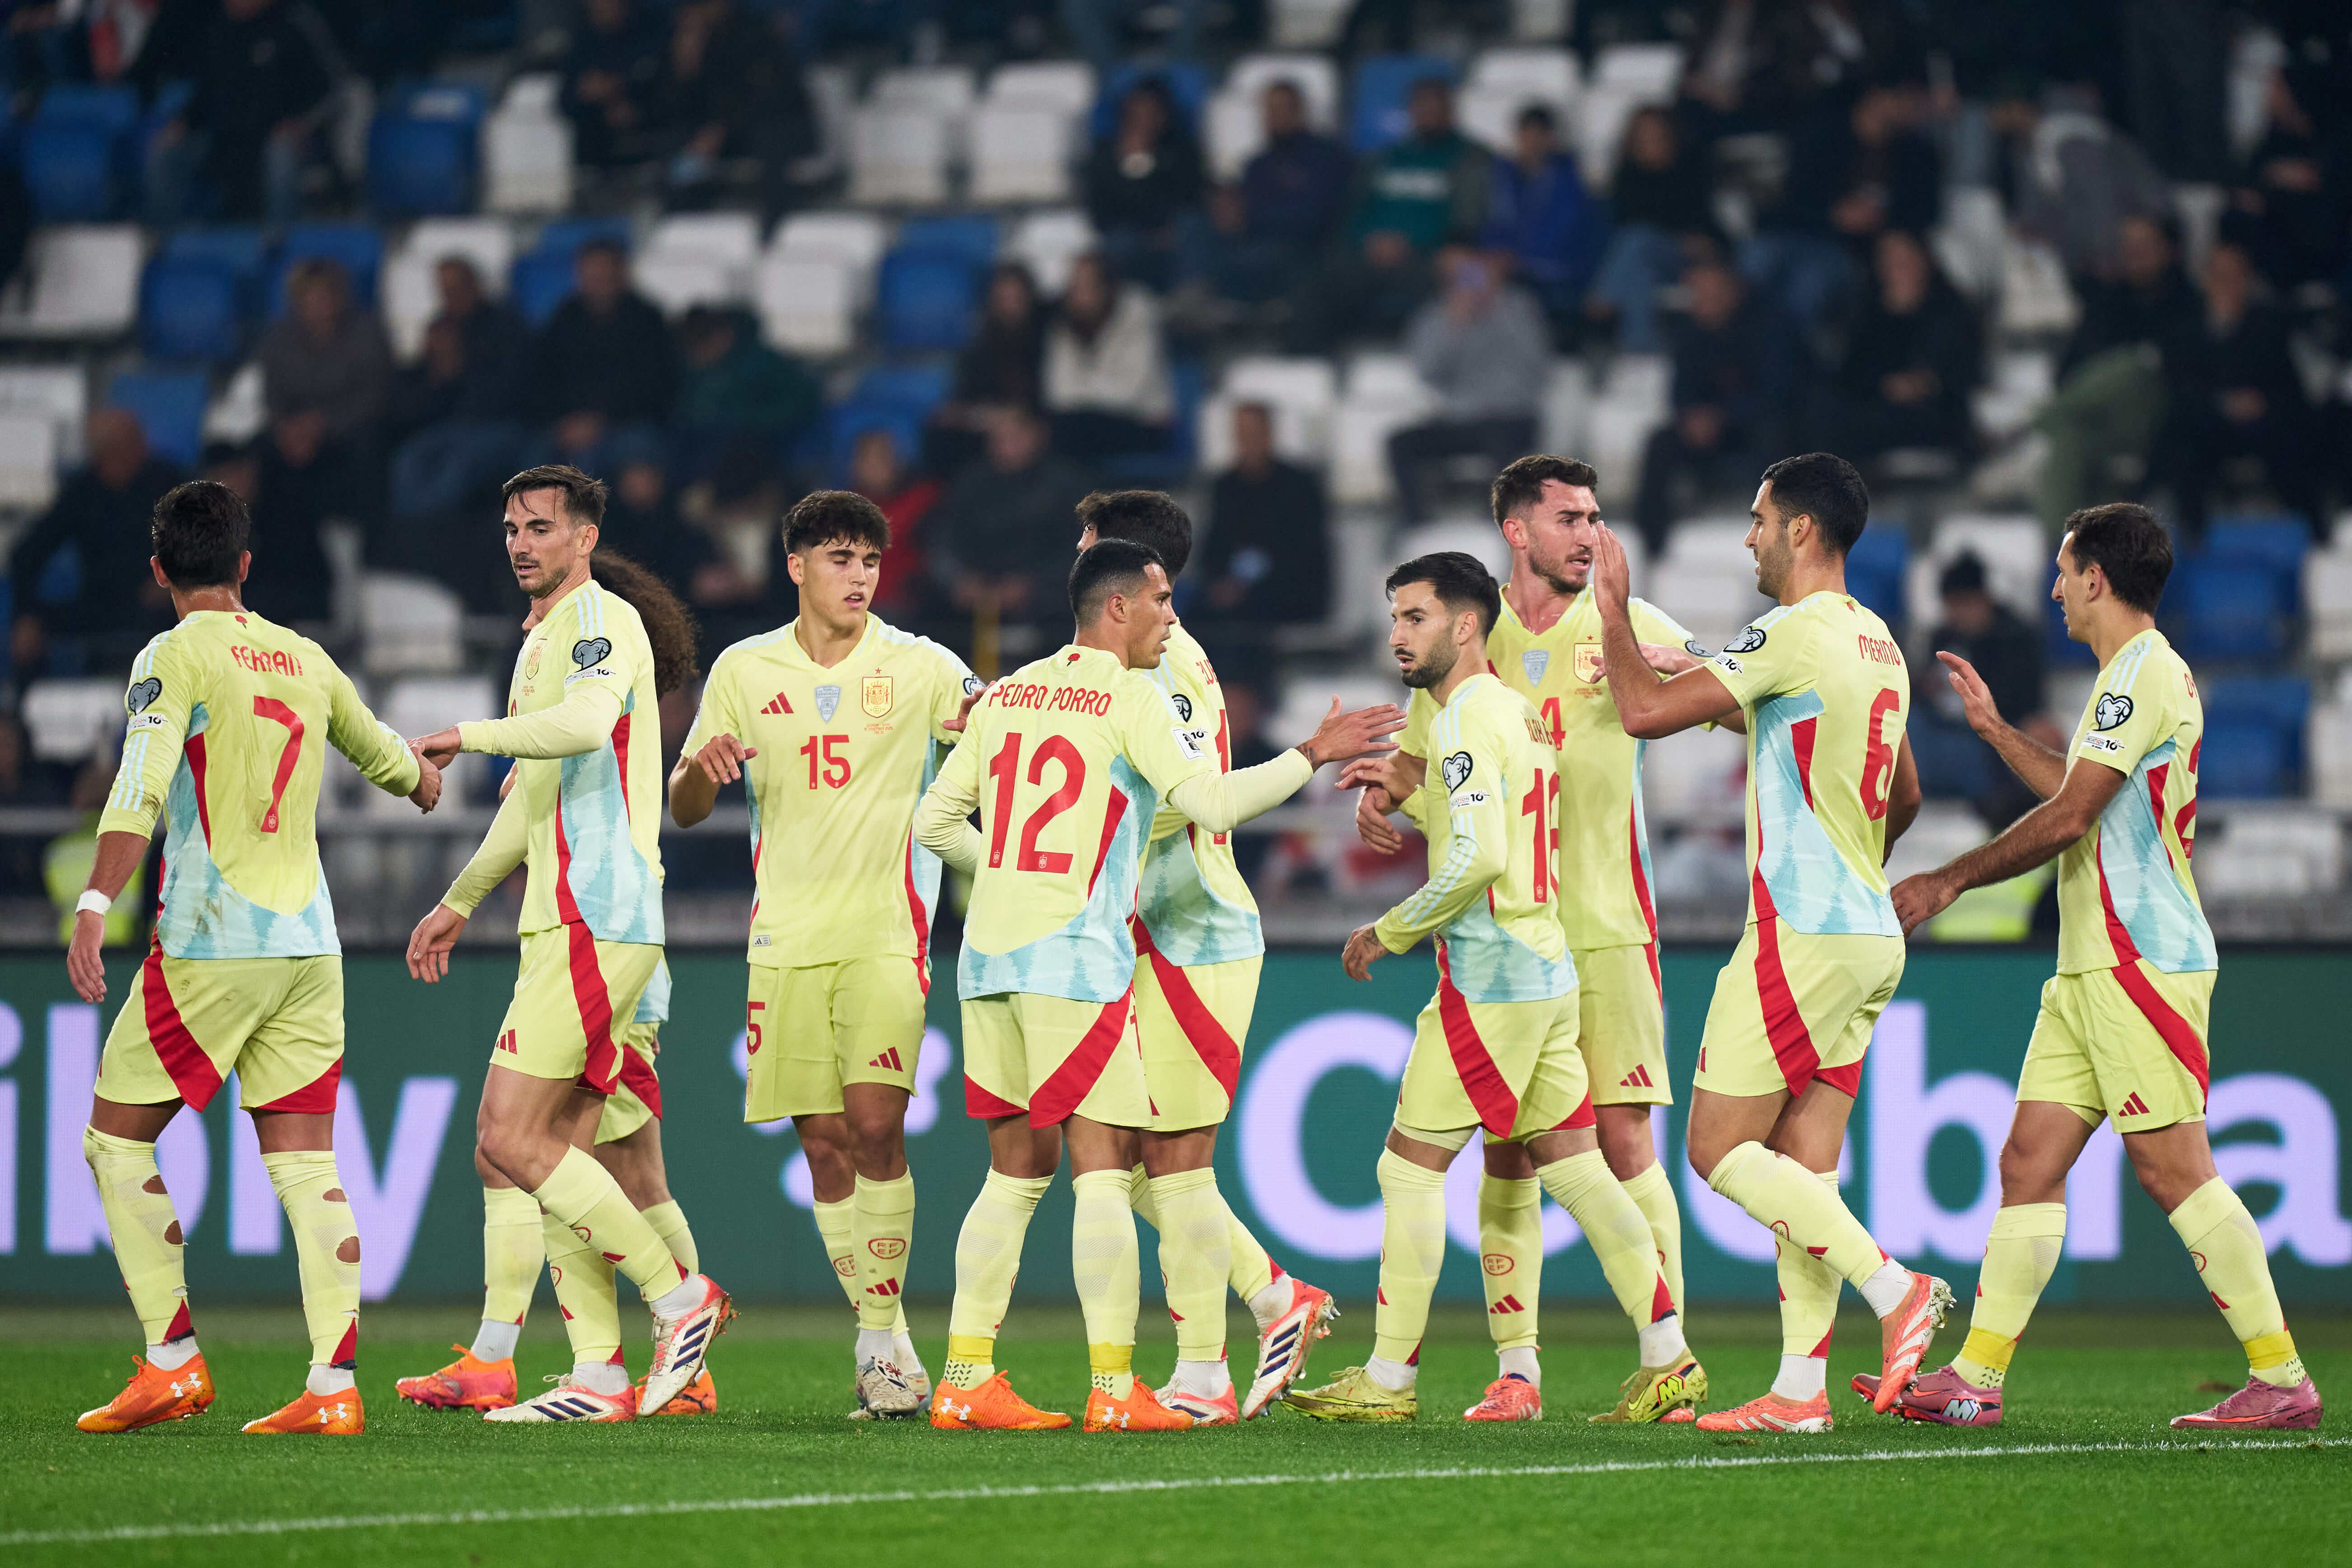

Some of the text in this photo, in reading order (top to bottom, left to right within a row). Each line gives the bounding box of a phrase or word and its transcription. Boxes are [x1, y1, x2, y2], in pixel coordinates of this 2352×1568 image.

[1859, 634, 1901, 666] MERINO
[989, 683, 1112, 717] PEDRO PORRO
[253, 695, 305, 833] 7
[800, 734, 851, 790] 15
[1860, 688, 1899, 821] 6
[989, 732, 1086, 875] 12
